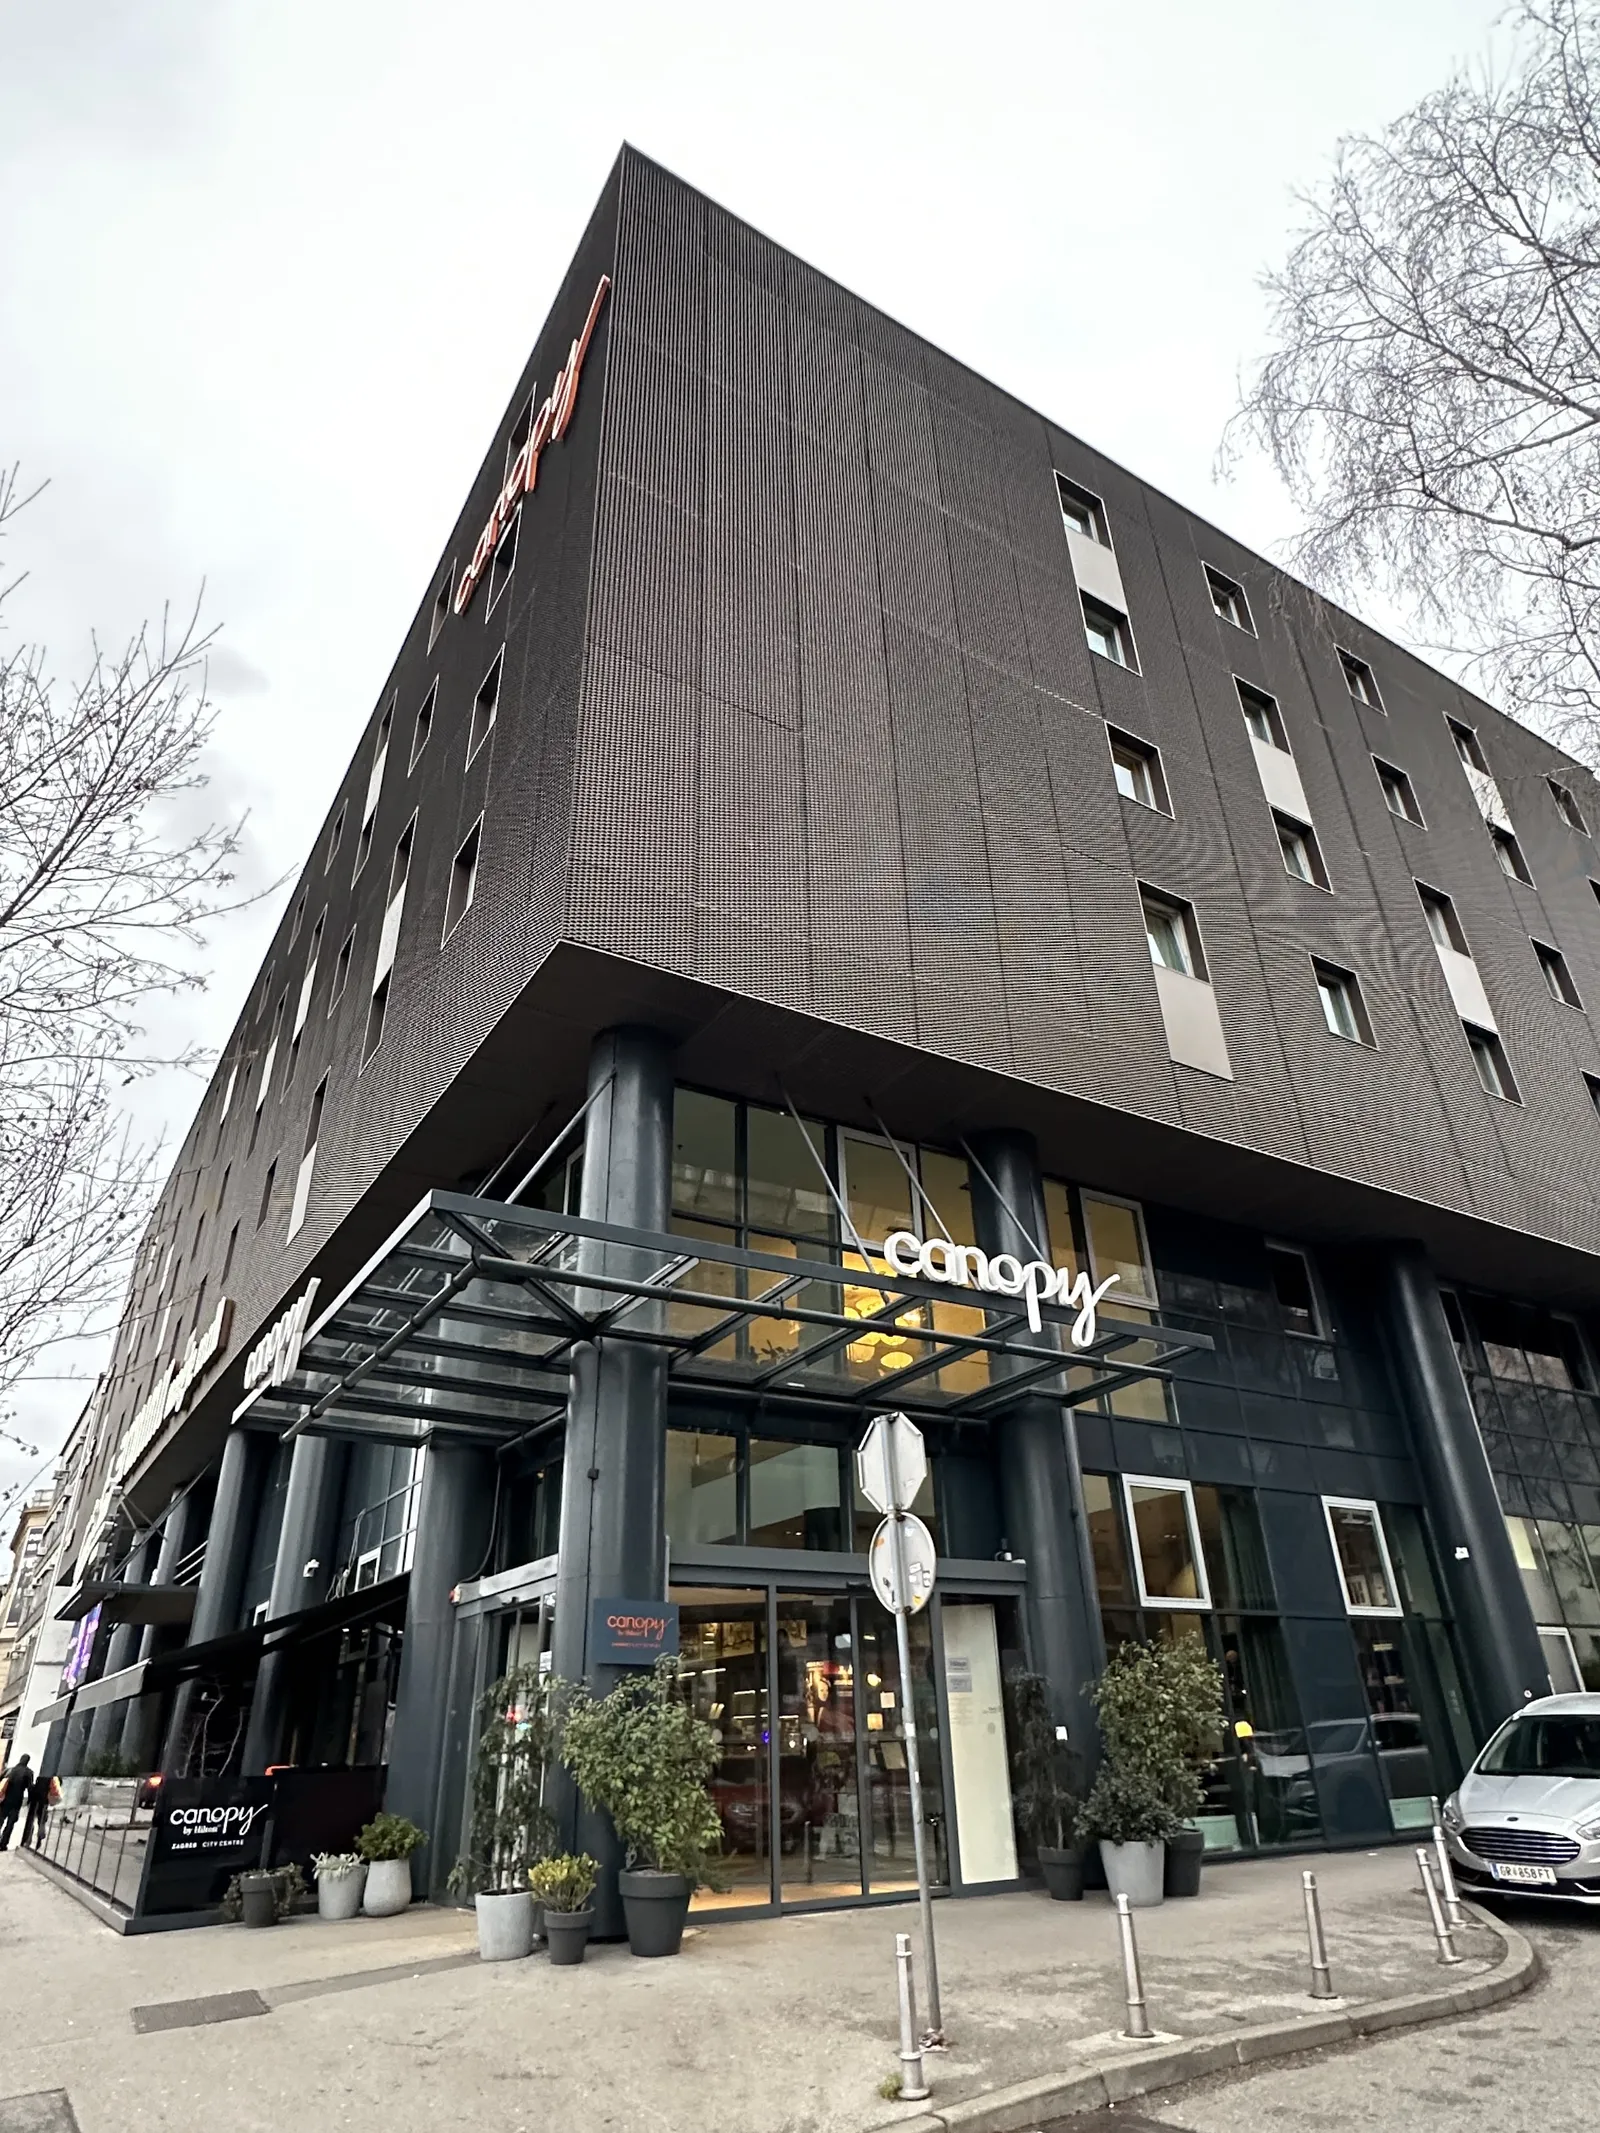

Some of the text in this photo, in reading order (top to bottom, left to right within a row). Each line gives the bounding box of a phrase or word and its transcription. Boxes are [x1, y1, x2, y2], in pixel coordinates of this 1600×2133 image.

[884, 1231, 1120, 1347] canopy
[607, 1615, 675, 1641] canopy
[170, 1804, 268, 1835] canopy
[183, 1826, 192, 1835] by
[171, 1839, 244, 1850] ZAGREB CITY CENTRE
